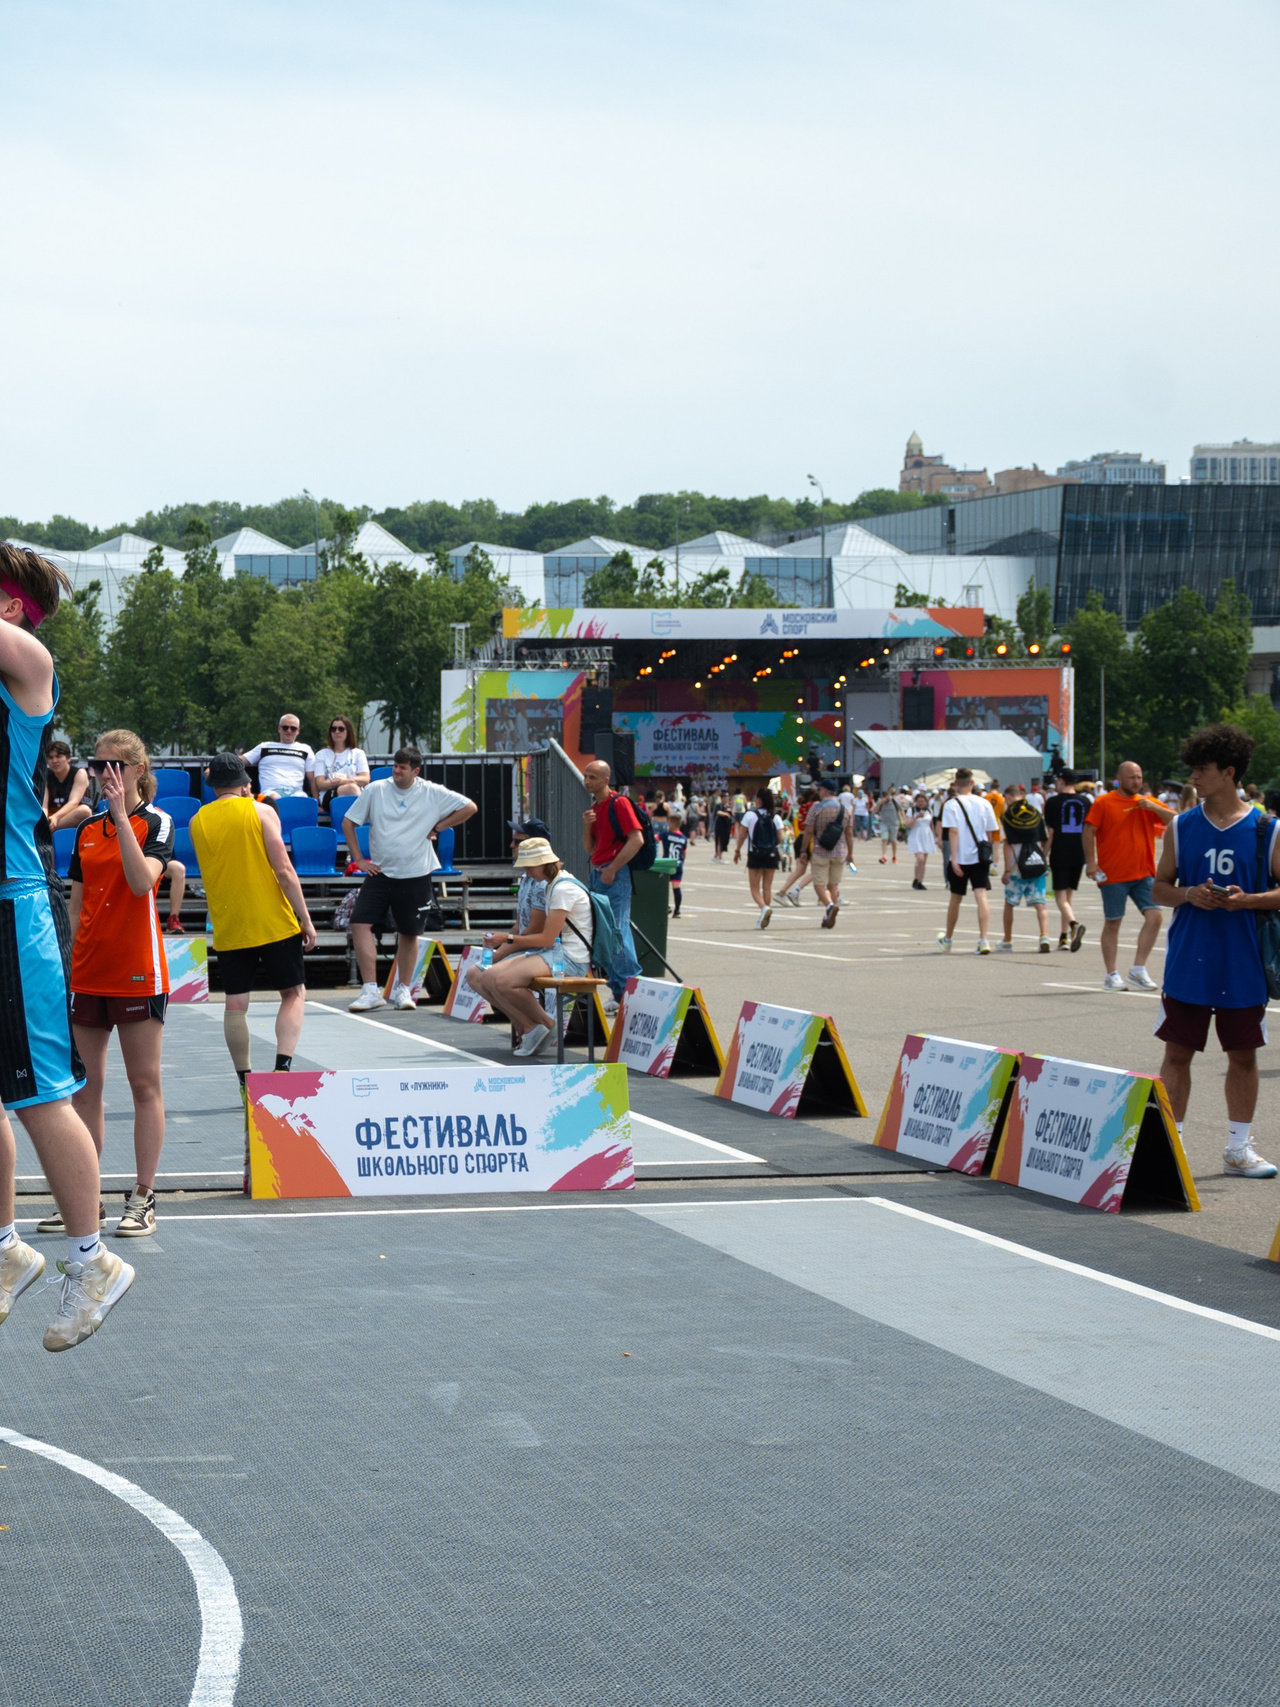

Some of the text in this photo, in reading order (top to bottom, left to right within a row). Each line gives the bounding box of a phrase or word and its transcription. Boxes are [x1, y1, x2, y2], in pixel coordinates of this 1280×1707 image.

[782, 610, 837, 623] МОСКОВСКИЙ
[782, 624, 808, 635] СПОРТ
[653, 728, 719, 741] ФЕСТИВАЛЬ
[1203, 848, 1235, 876] 16
[745, 1041, 783, 1074] ФЕСТИВАЛЬ
[399, 1081, 449, 1092] ОК «ЛУЖНИКИ»
[488, 1075, 526, 1085] МОСКОВСКИЙ
[488, 1084, 507, 1093] СПОРТ
[913, 1083, 962, 1122] ФЕСТИВАЛЬ
[355, 1113, 528, 1150] ФЕСТИВАЛЬ
[1035, 1108, 1092, 1153] ФЕСТИВАЛЬ
[357, 1152, 529, 1177] ШКОЛЬНОГО СПОРТА
